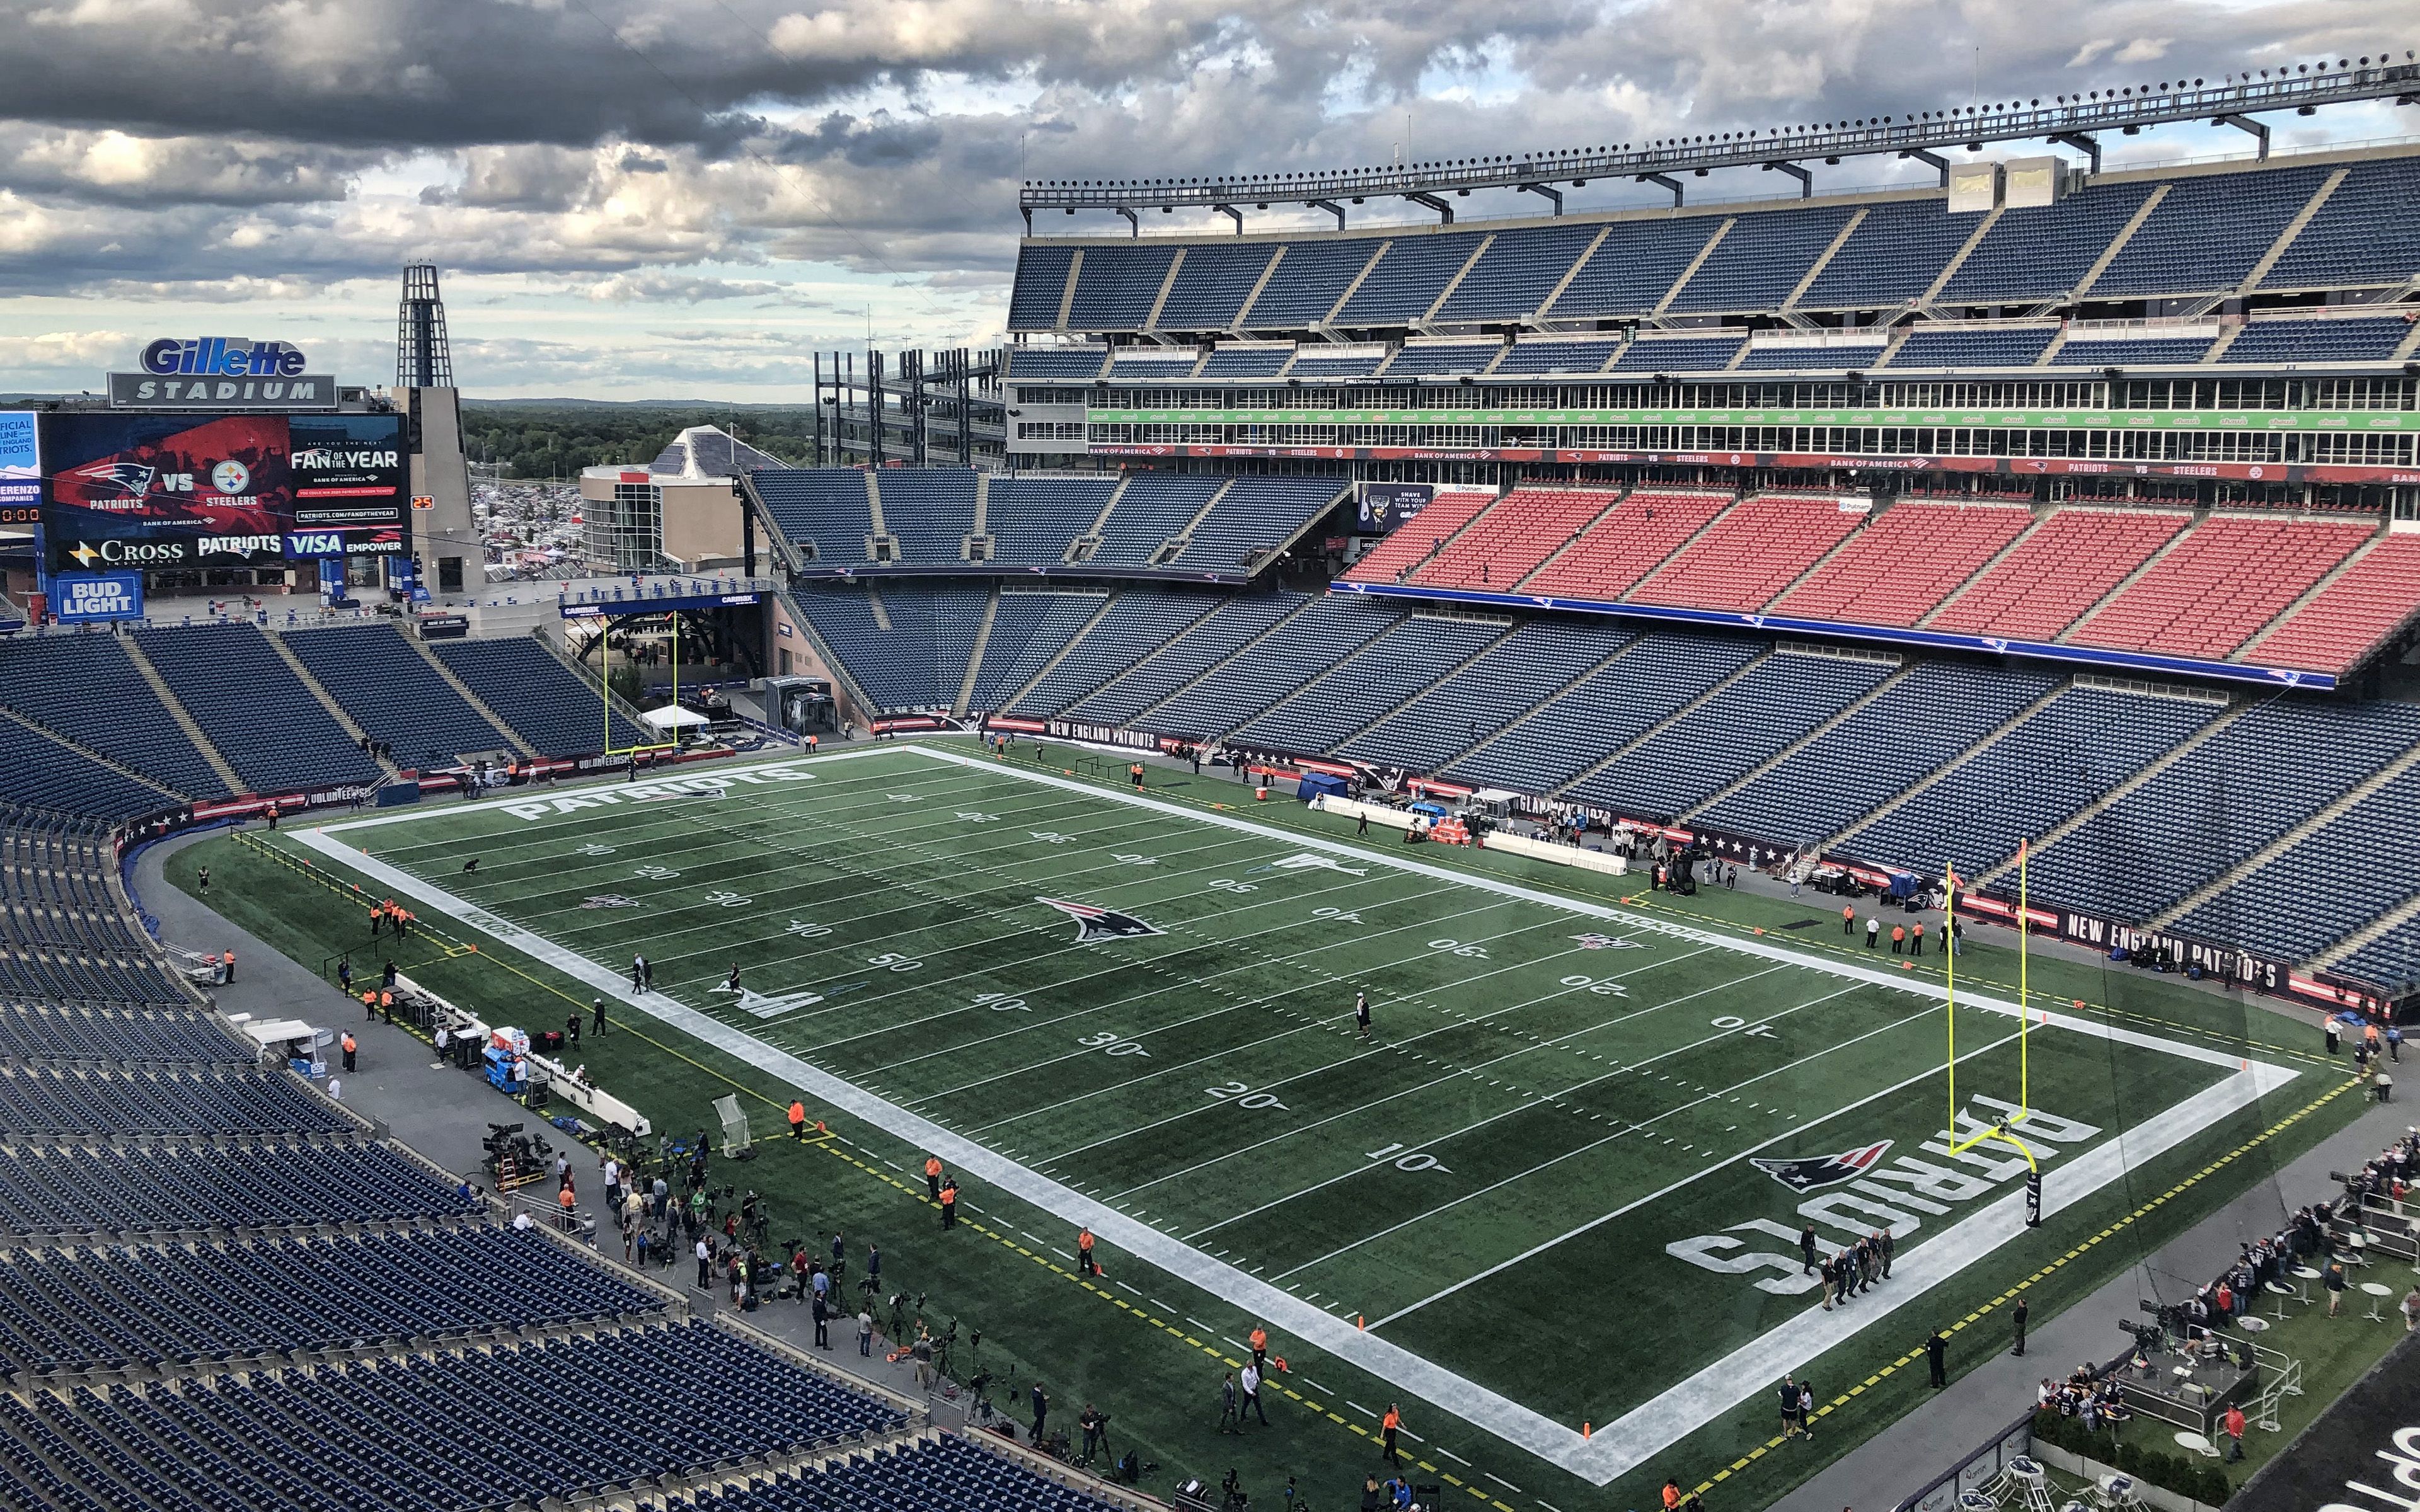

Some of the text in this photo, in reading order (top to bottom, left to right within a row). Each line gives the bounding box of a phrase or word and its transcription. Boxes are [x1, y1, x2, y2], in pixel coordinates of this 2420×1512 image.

[144, 338, 305, 377] Gillette
[137, 381, 315, 400] STADIUM
[291, 452, 331, 469] FAN
[331, 460, 345, 468] THE
[333, 452, 343, 460] OF
[345, 451, 398, 468] YEAR
[2068, 463, 2218, 476] PATRIOTS VS STEELERS
[2392, 474, 2420, 483] BAN
[161, 473, 193, 491] VS
[90, 499, 143, 510] PATRIOTS
[206, 496, 257, 507] STEELERS
[413, 497, 432, 509] 25
[301, 510, 394, 518] PATRIOTS.COM/FANOFTHEYEAR
[198, 536, 281, 557] PATRIOTS
[287, 534, 342, 554] VISA
[347, 542, 402, 553] EMPOWER
[72, 582, 122, 598] BUD
[63, 596, 131, 615] LIGHT
[1050, 721, 1155, 748] NEW ENGLAND PATRIOTS
[500, 768, 817, 821] PATRIOTS
[458, 911, 524, 937] KICKOFF
[2068, 914, 2104, 943] NEW
[1427, 939, 1488, 958] 30
[867, 953, 925, 972] 50
[1559, 975, 1628, 996] 20
[970, 993, 1027, 1011] 40
[1710, 1016, 1775, 1037] 10
[1076, 1031, 1143, 1057] 30
[1203, 1082, 1279, 1110] 20
[1365, 1142, 1439, 1173] 10
